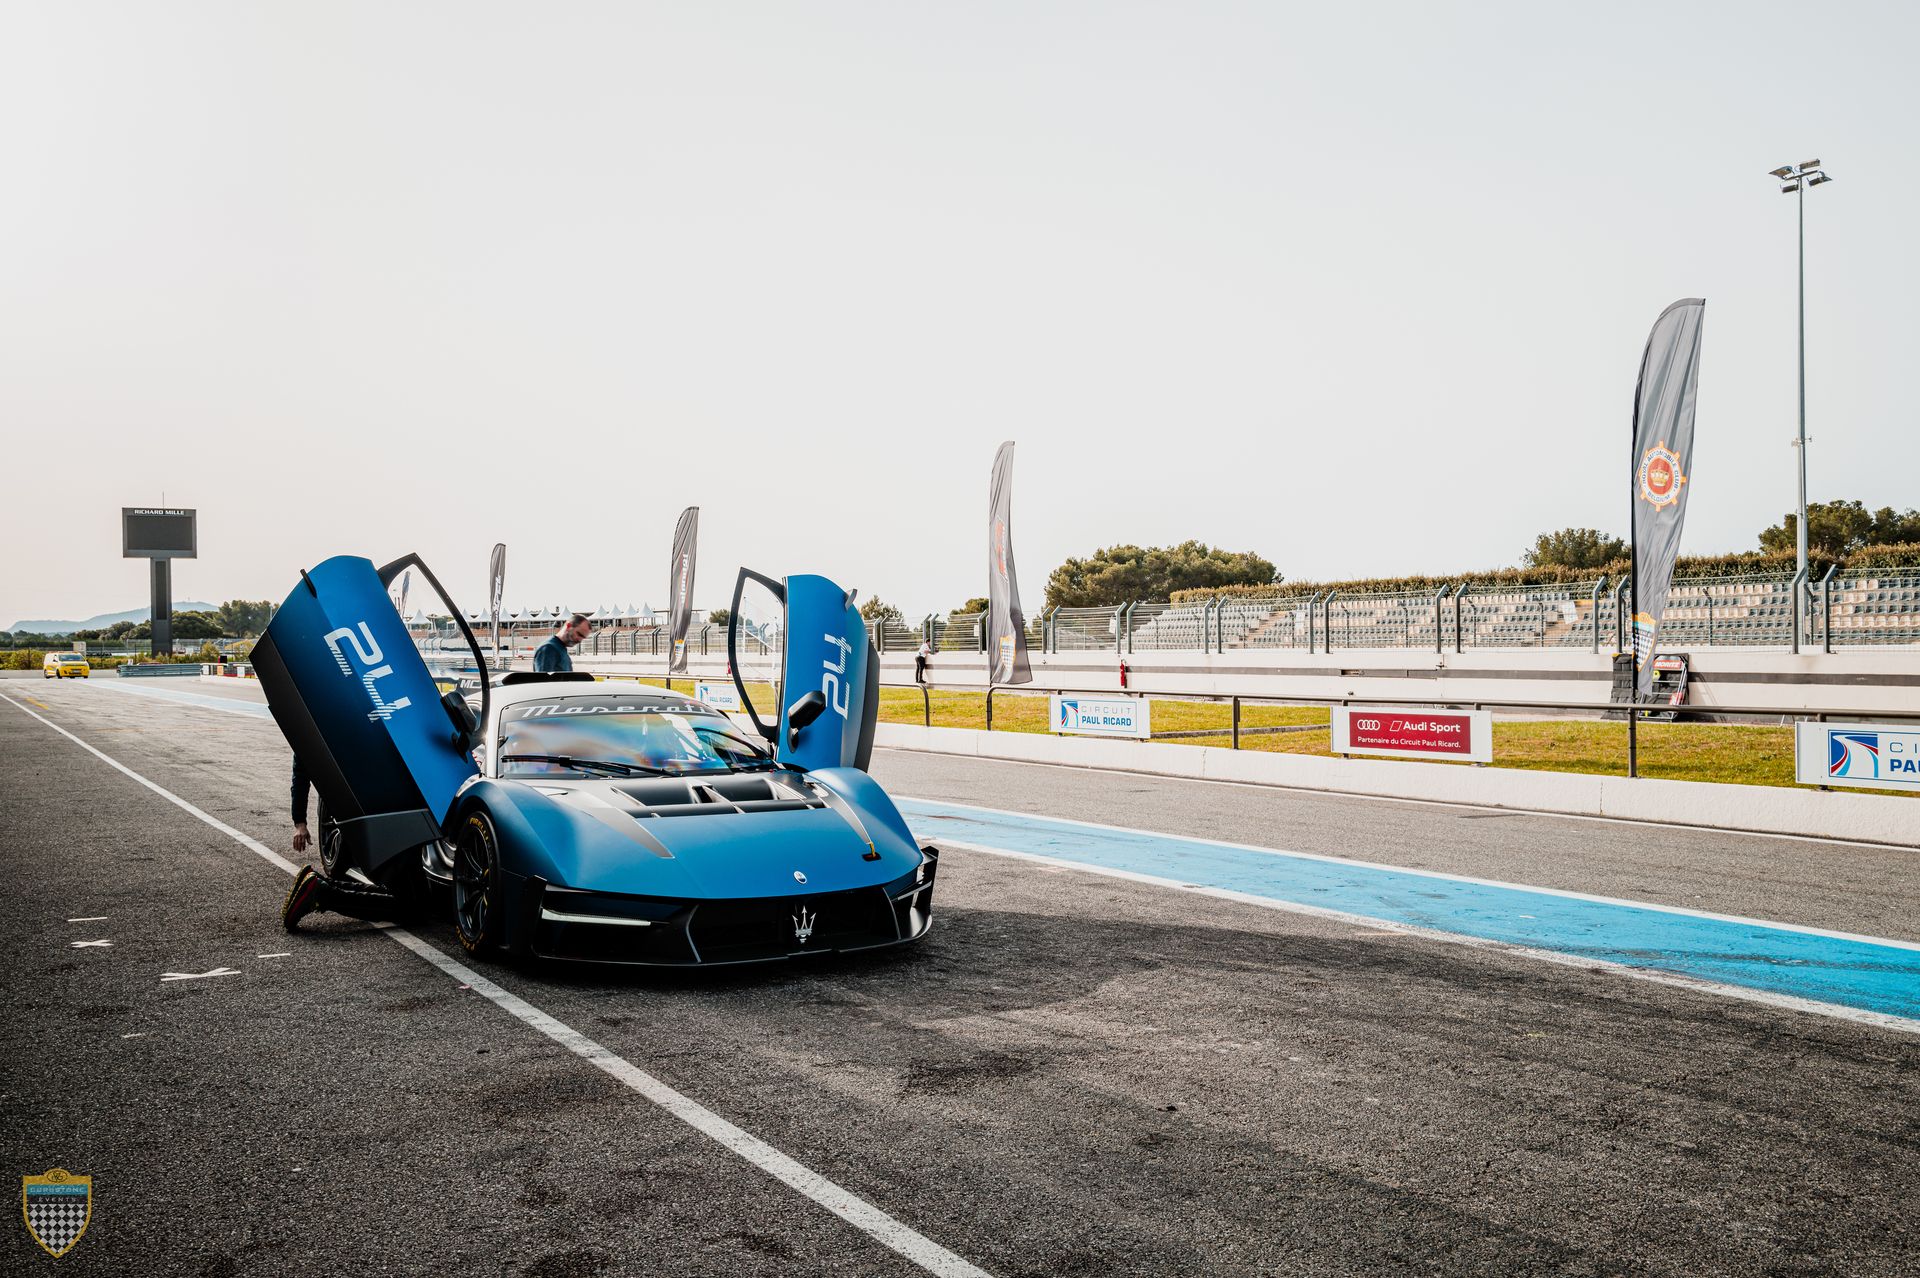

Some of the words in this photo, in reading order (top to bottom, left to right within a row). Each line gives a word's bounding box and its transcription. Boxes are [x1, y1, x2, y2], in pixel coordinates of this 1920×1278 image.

[323, 621, 412, 722] 24
[822, 633, 852, 720] 24
[517, 704, 712, 718] Maserati
[1082, 706, 1131, 714] CIRCUIT
[1082, 716, 1100, 724] PAUL
[1103, 717, 1131, 726] RICARD
[1403, 721, 1428, 731] Audi
[1430, 722, 1461, 733] Sport
[1357, 736, 1390, 744] Partenaire
[1400, 738, 1421, 746] Circuit
[1437, 740, 1461, 748] Ricard.
